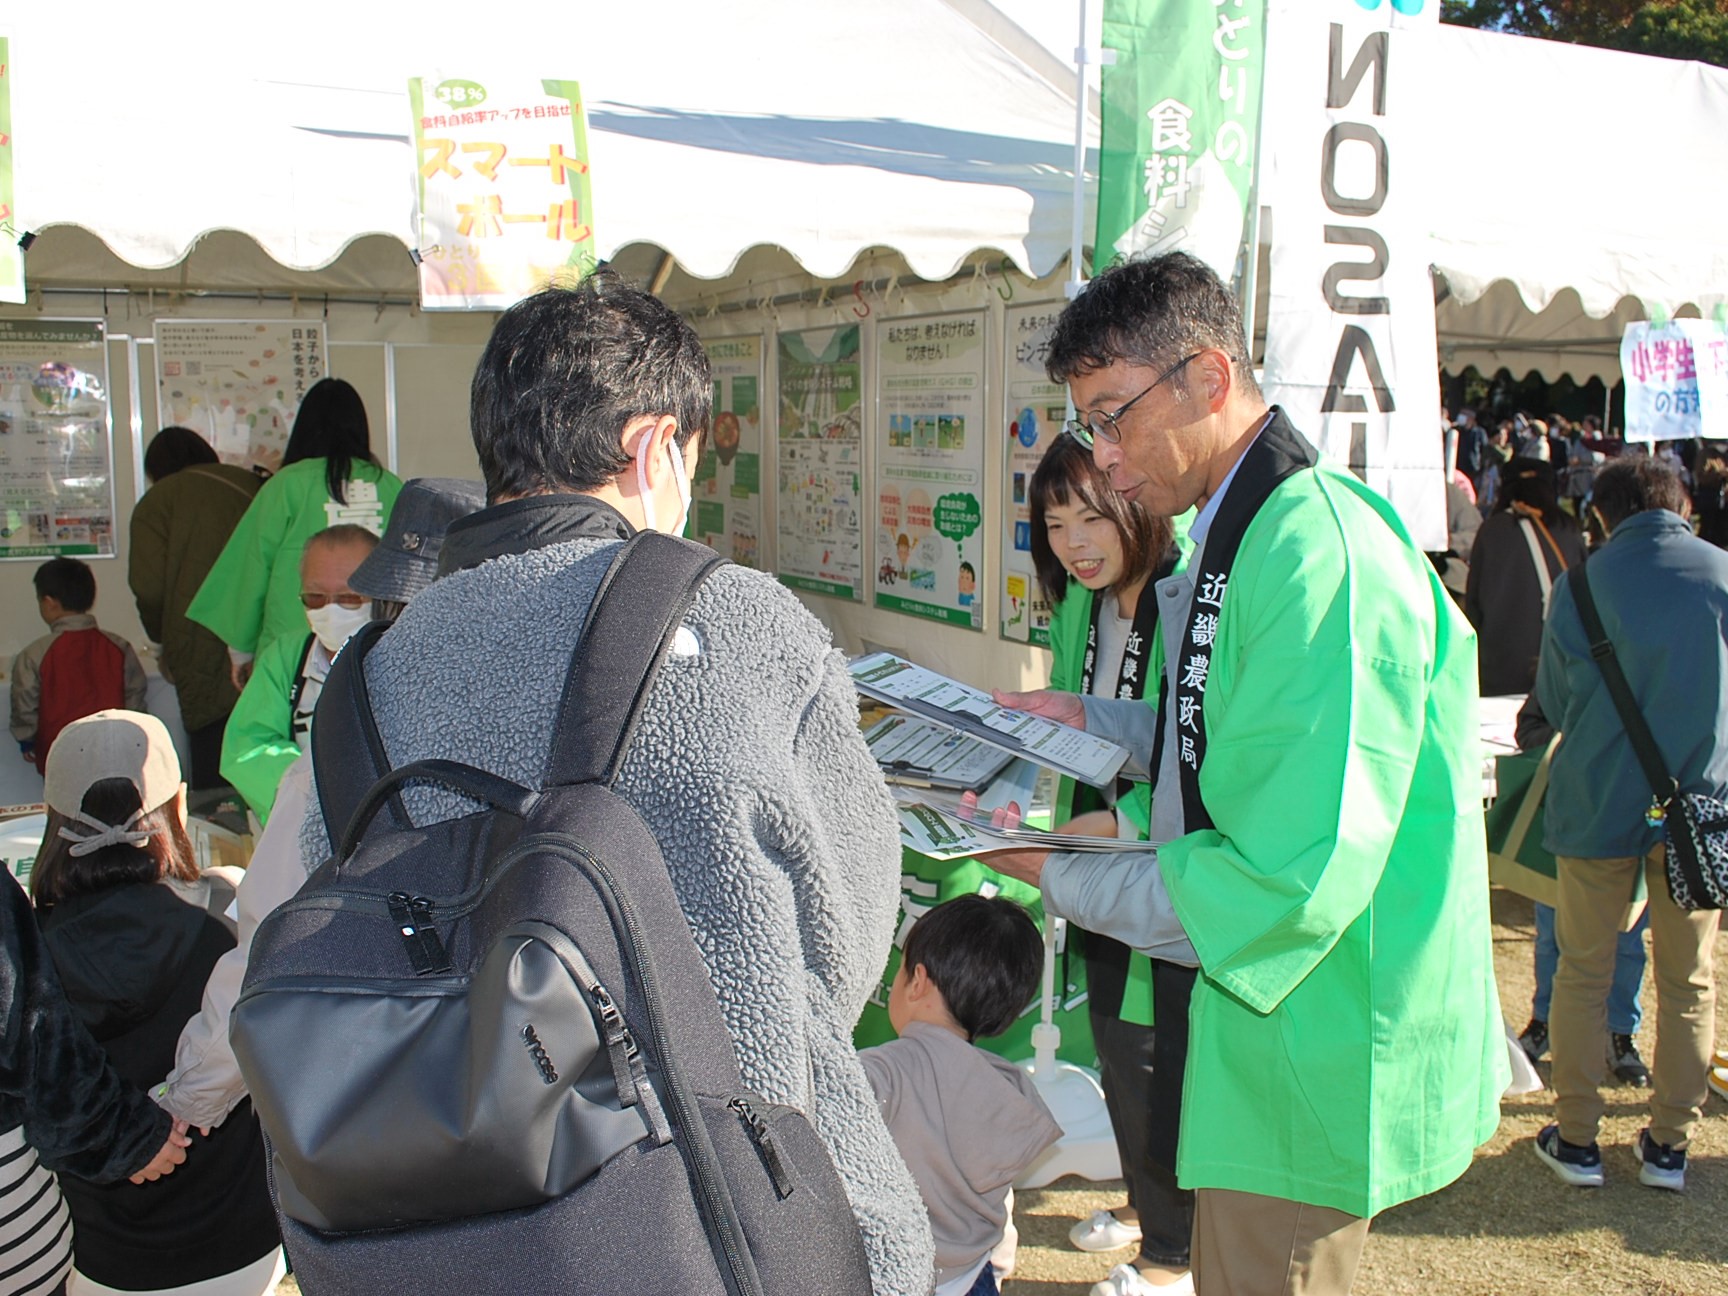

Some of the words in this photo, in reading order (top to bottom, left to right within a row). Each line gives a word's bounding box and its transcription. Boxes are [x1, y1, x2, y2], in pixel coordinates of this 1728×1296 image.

[419, 138, 588, 185] スマート
[456, 194, 591, 242] ボール
[1178, 572, 1228, 771] 近畿農政局
